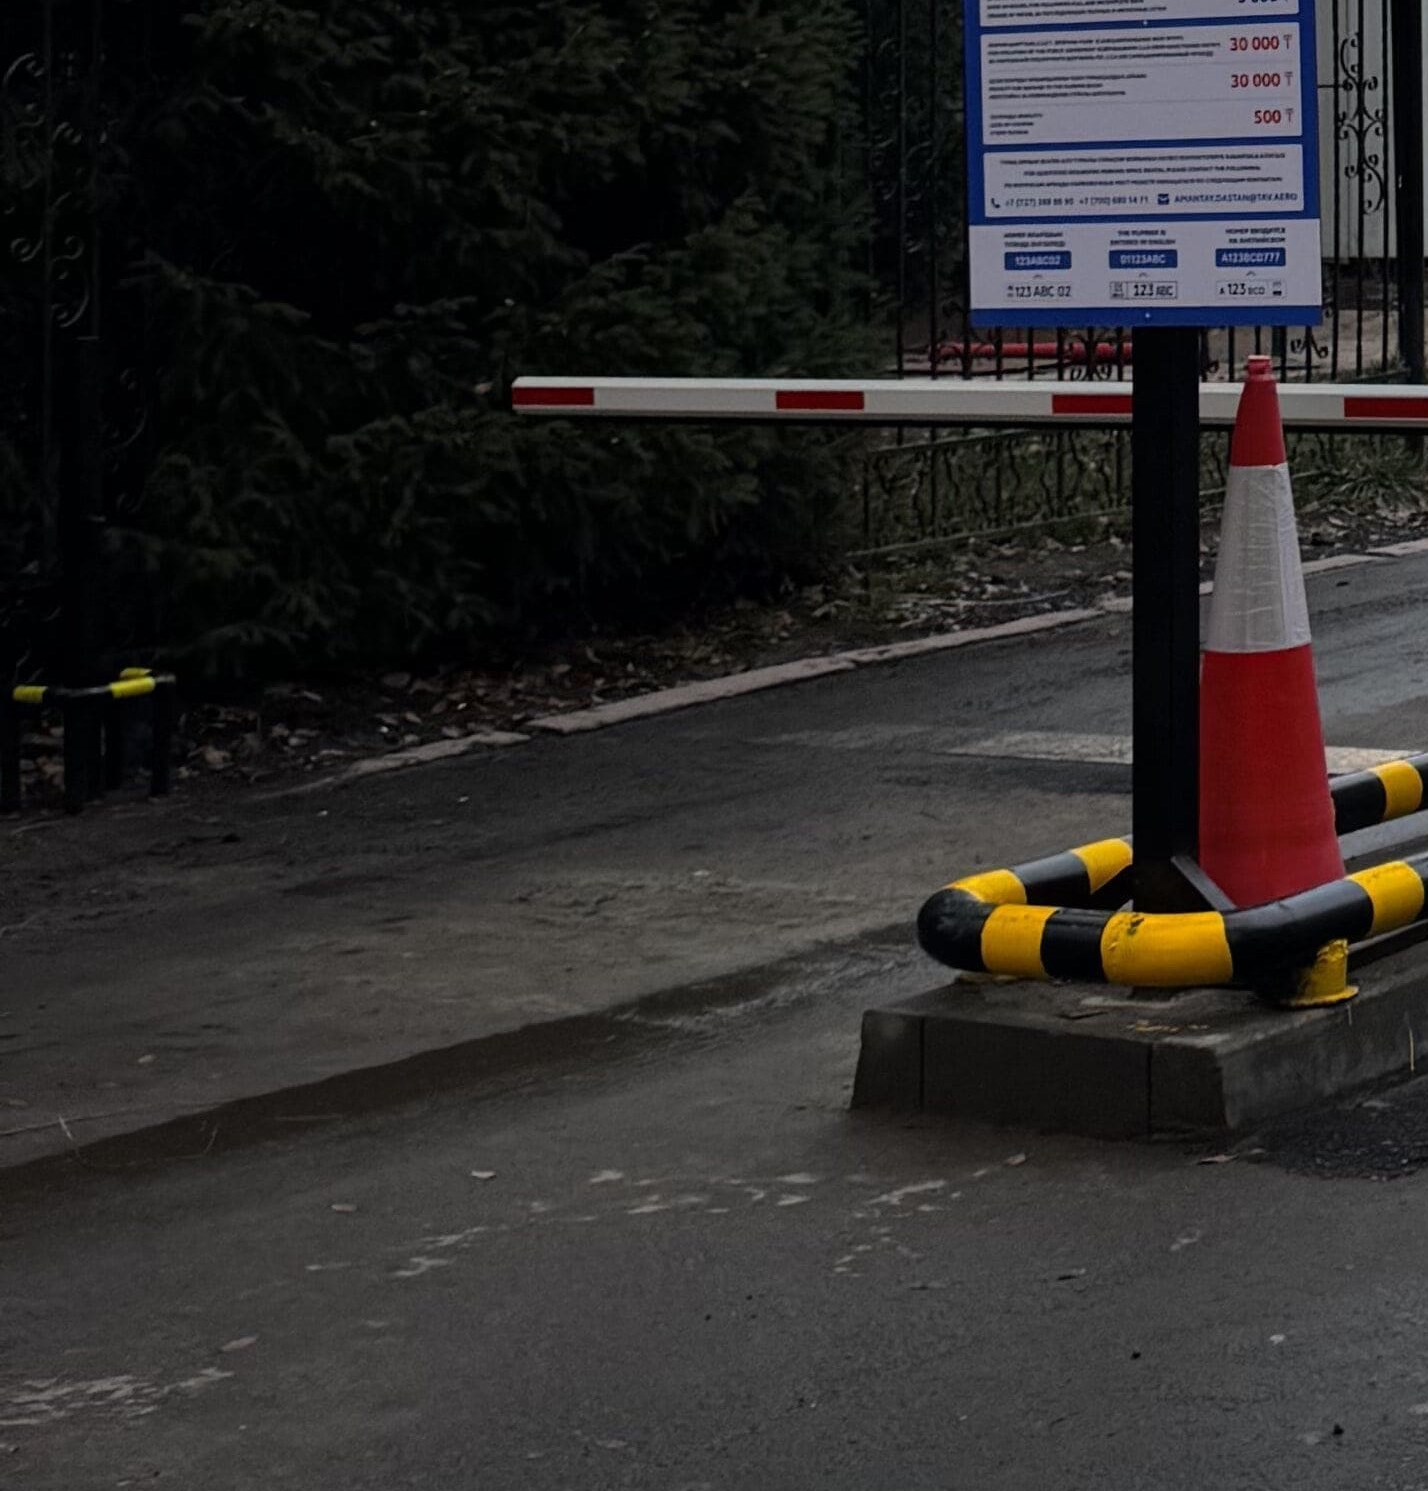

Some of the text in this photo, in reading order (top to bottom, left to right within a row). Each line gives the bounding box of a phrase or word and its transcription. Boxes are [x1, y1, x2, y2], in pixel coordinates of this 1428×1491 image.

[1230, 37, 1248, 51] 30
[1253, 36, 1279, 50] 000
[1231, 75, 1249, 88] 30
[1254, 73, 1280, 87] 000
[1254, 110, 1281, 124] 500
[1015, 286, 1031, 297] 123
[1034, 286, 1054, 296] ABC
[1057, 286, 1071, 296] 02
[1134, 284, 1153, 296] 123
[1228, 283, 1246, 295] 123
